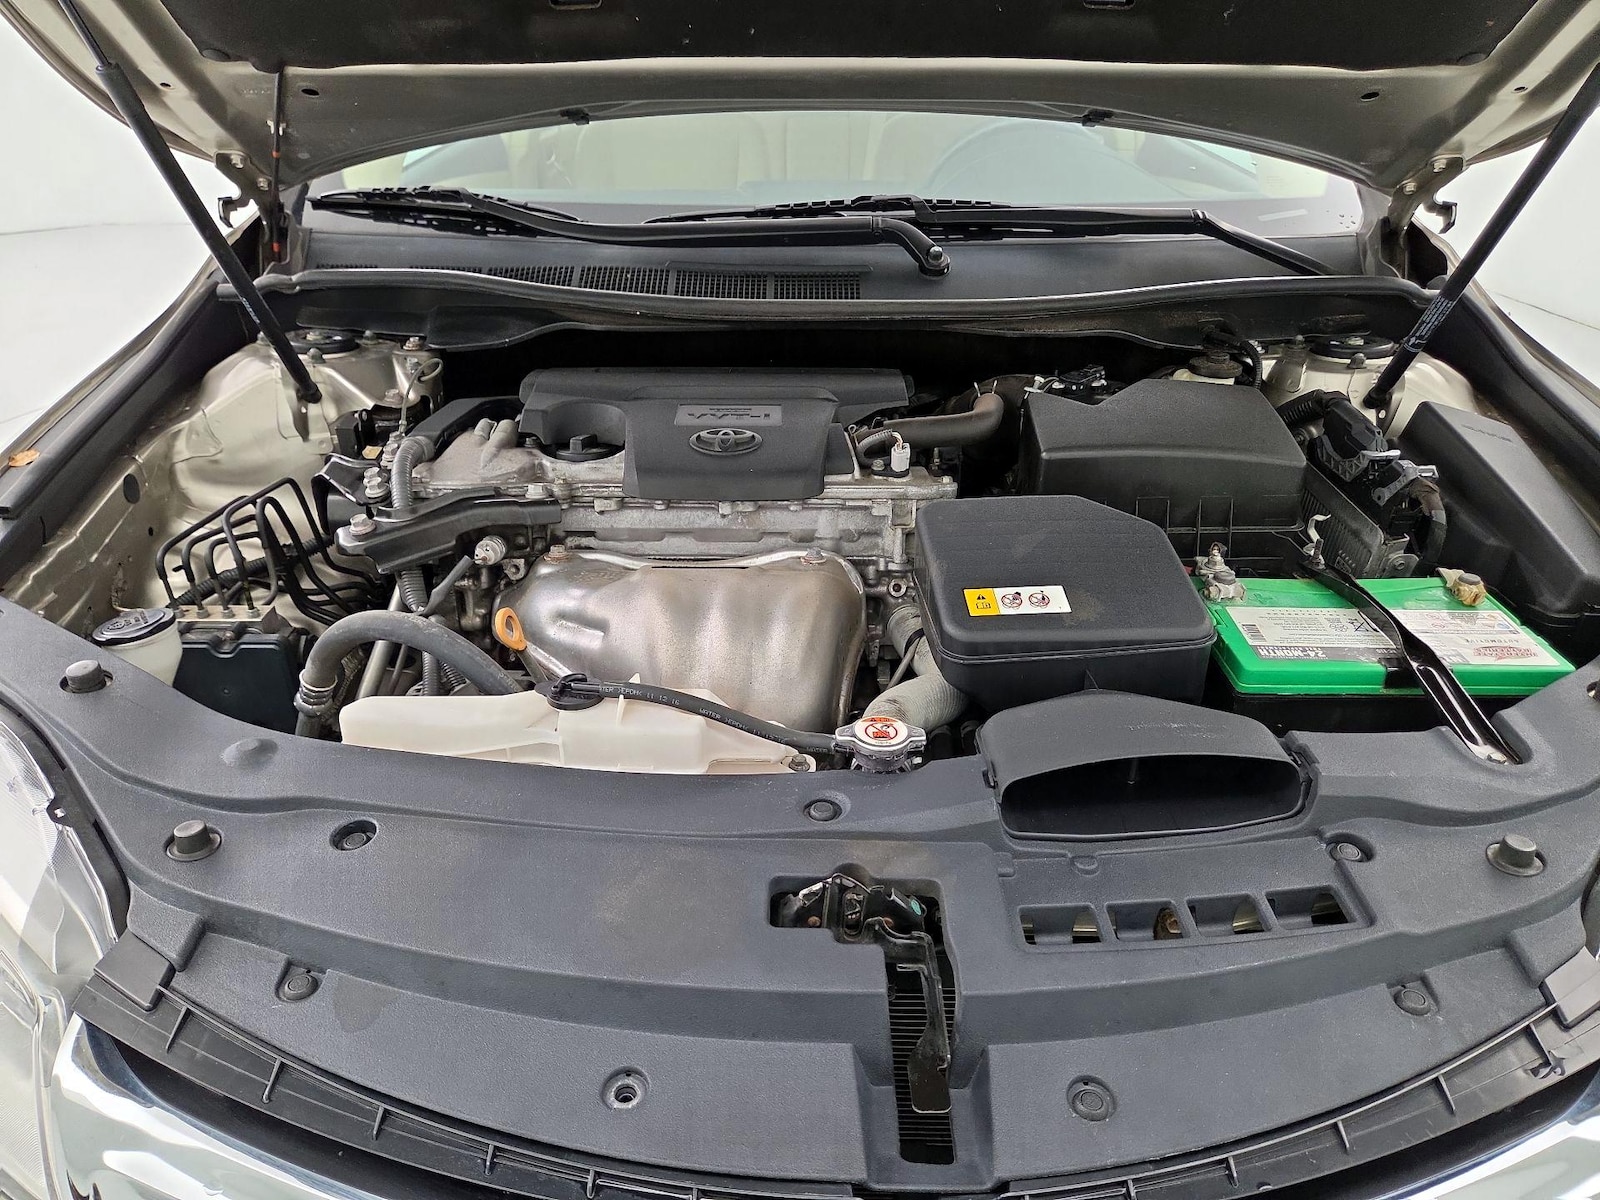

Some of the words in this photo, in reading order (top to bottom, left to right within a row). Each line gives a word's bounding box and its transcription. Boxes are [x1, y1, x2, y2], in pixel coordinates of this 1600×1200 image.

[1258, 648, 1327, 658] 24-MONTH
[600, 686, 614, 694] TER
[699, 707, 722, 721] WATER
